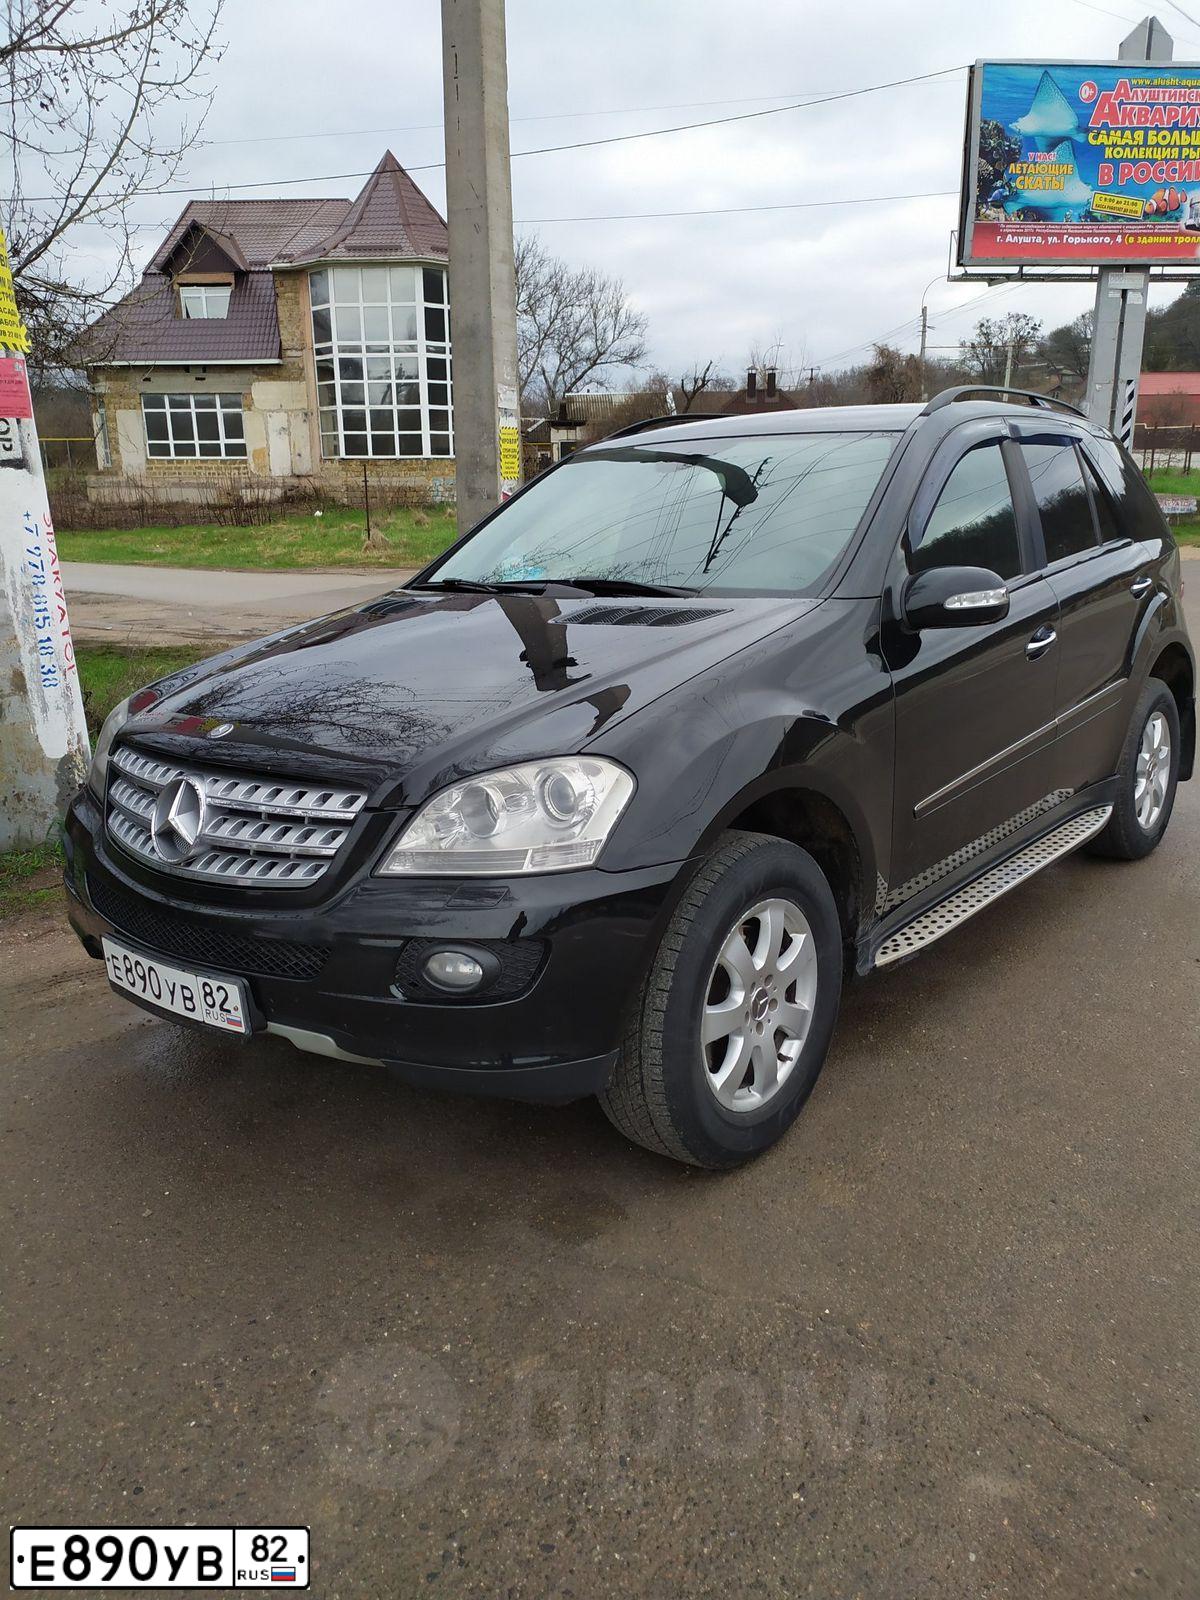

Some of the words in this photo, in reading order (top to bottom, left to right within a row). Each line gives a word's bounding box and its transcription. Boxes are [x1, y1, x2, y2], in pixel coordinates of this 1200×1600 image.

[1088, 130, 1144, 145] САМАЯ
[1104, 147, 1179, 160] КОЛЛЕКЦИЯ
[1009, 163, 1073, 174] ЛЕТАЮЩИЕ
[1098, 163, 1114, 186] В
[1016, 175, 1065, 191] СКАТЫ
[1006, 234, 1045, 245] Алушта,
[1047, 236, 1060, 245] ул.
[1063, 235, 1113, 245] Горького,
[1115, 235, 1122, 243] 4
[1136, 236, 1172, 244] здании
[202, 981, 232, 1014] 82
[205, 1008, 226, 1023] RUS
